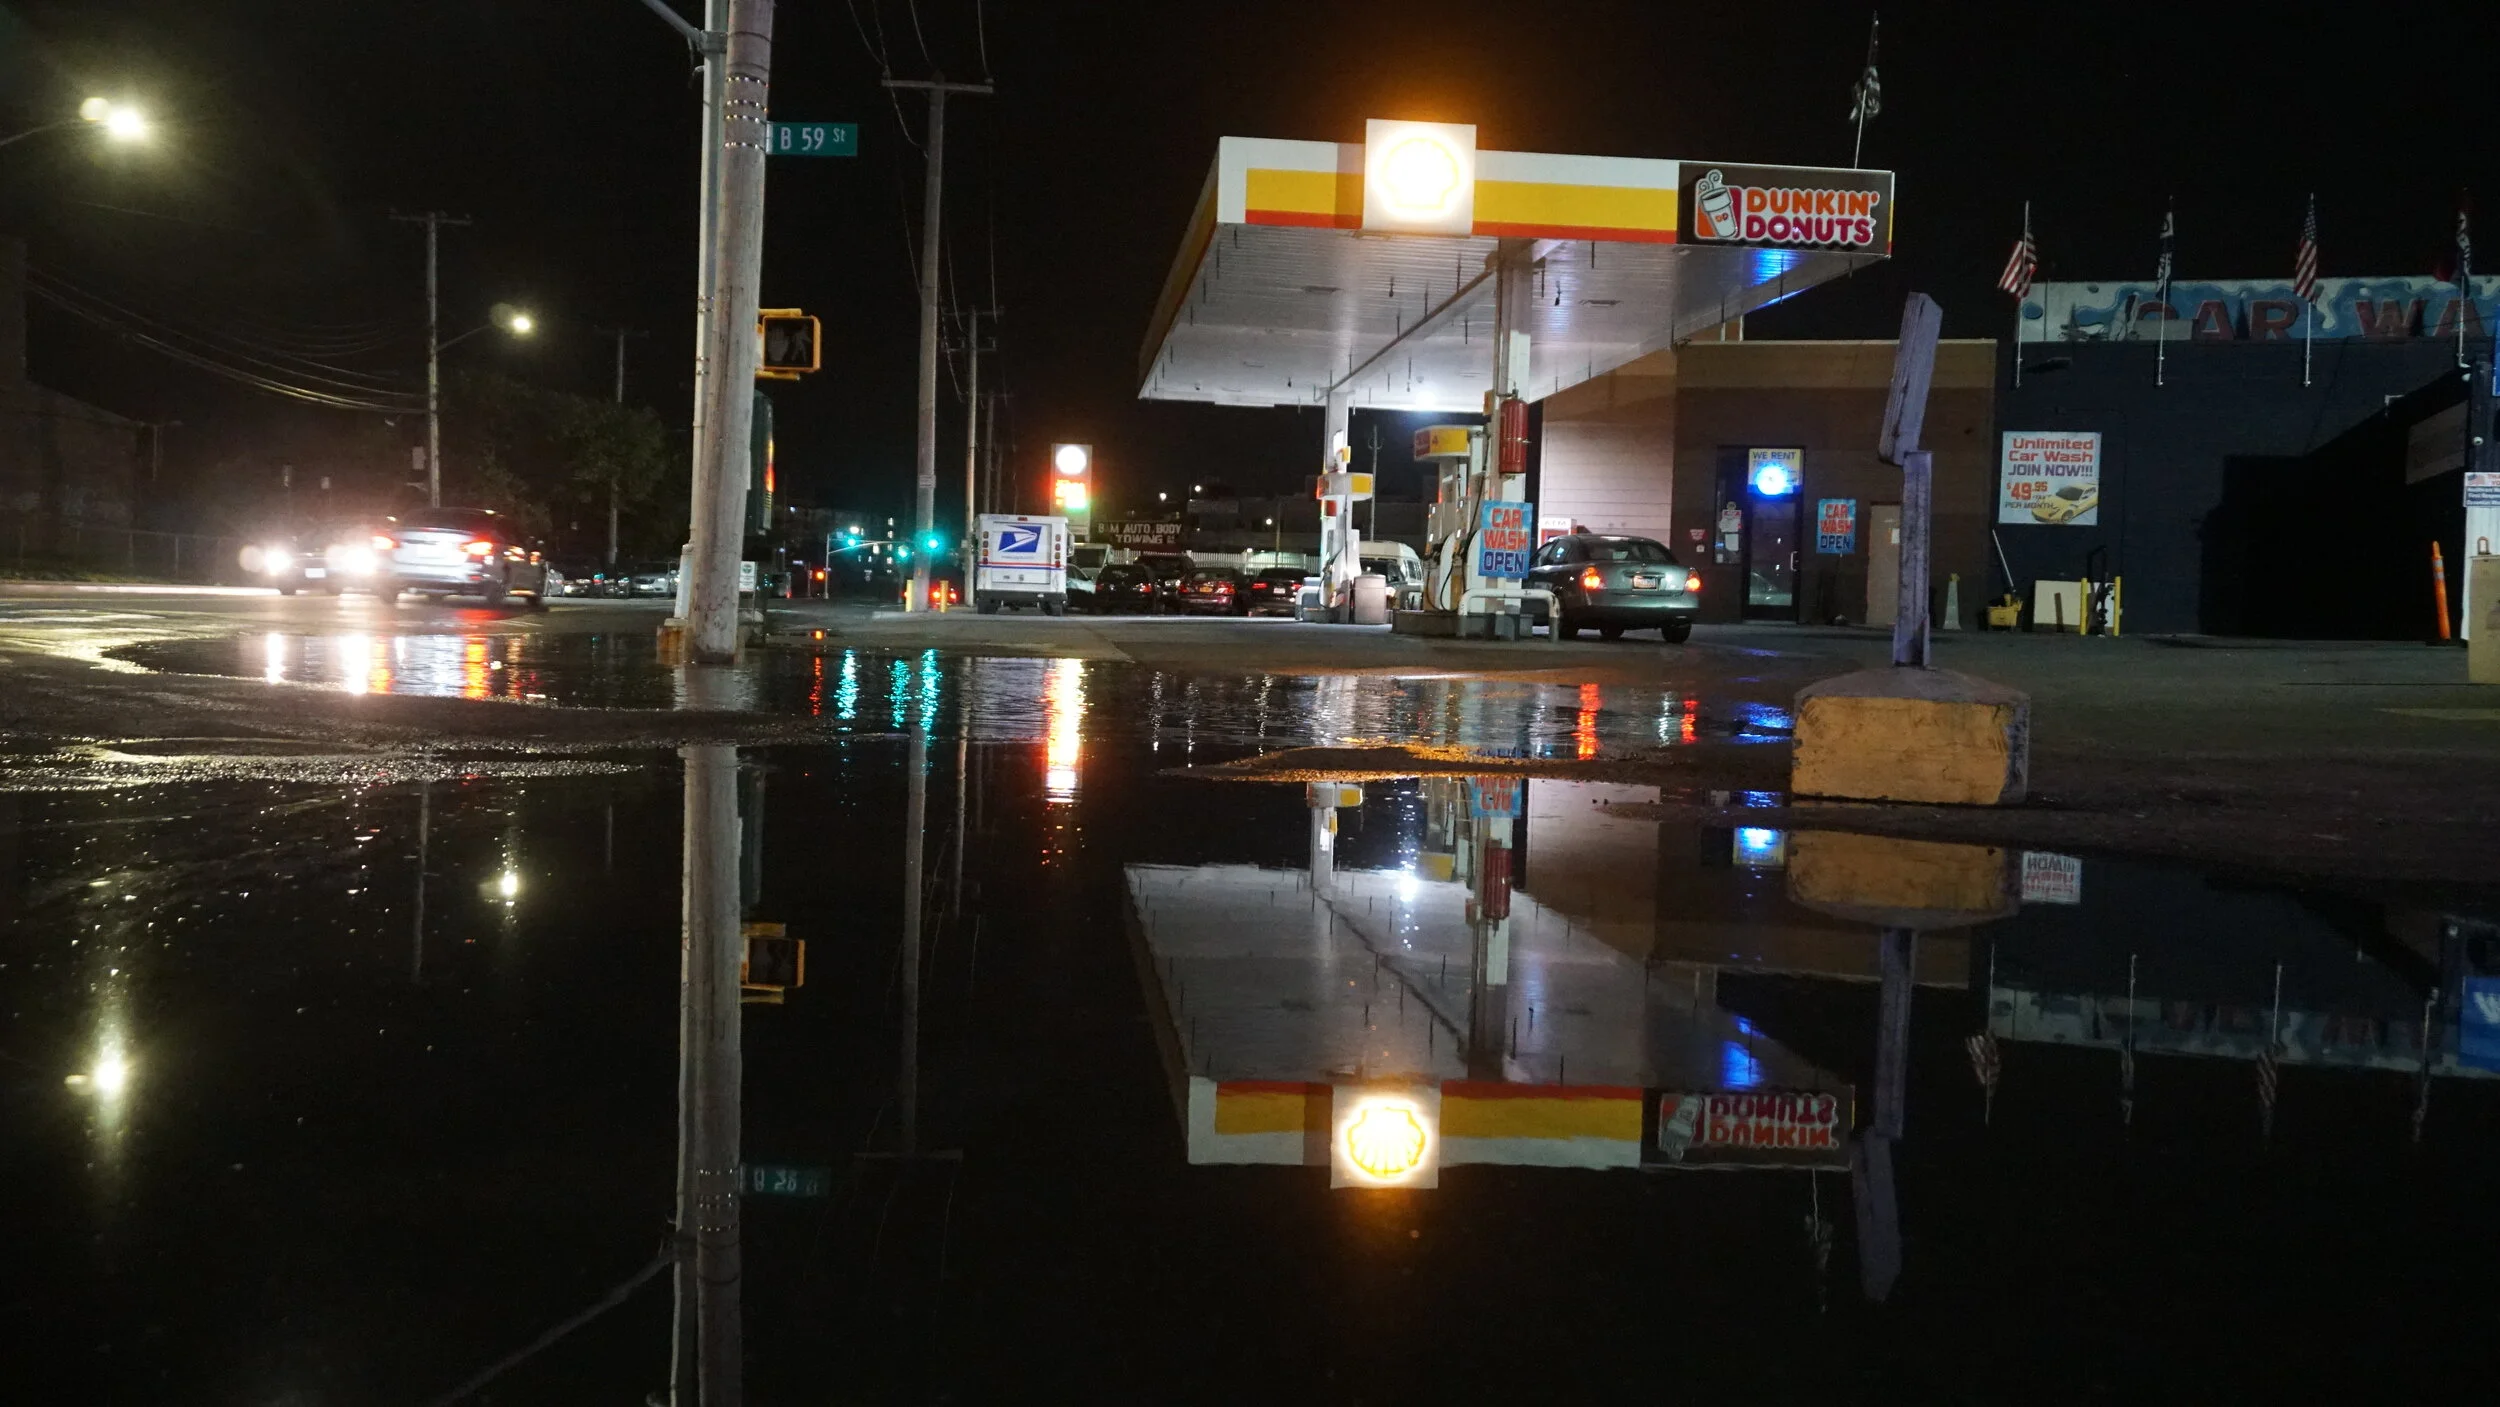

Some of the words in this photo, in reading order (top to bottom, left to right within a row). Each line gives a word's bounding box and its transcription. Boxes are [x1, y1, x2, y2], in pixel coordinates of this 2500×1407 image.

[780, 127, 792, 150] B
[801, 127, 825, 150] 59
[833, 127, 846, 142] St
[1746, 187, 1879, 217] DUNKIN'
[1746, 215, 1872, 244] DONUTS
[2013, 438, 2094, 450] Unlimited
[1752, 451, 1768, 460] WE
[1771, 451, 1796, 460] RENT
[2008, 450, 2039, 462] Car
[2044, 451, 2093, 463] Wash
[2008, 463, 2041, 476] JOIN
[2045, 464, 2093, 477] NOW!!!
[1491, 508, 1523, 530] CAR
[1825, 504, 1849, 519] CAR
[1123, 523, 1152, 534] AUTO
[1155, 523, 1182, 534] BODY
[1820, 519, 1853, 534] WASH
[1115, 533, 1163, 544] TOWING
[1482, 529, 1529, 551] WASH
[1820, 535, 1851, 549] OPEN
[1483, 551, 1524, 573] OPEN
